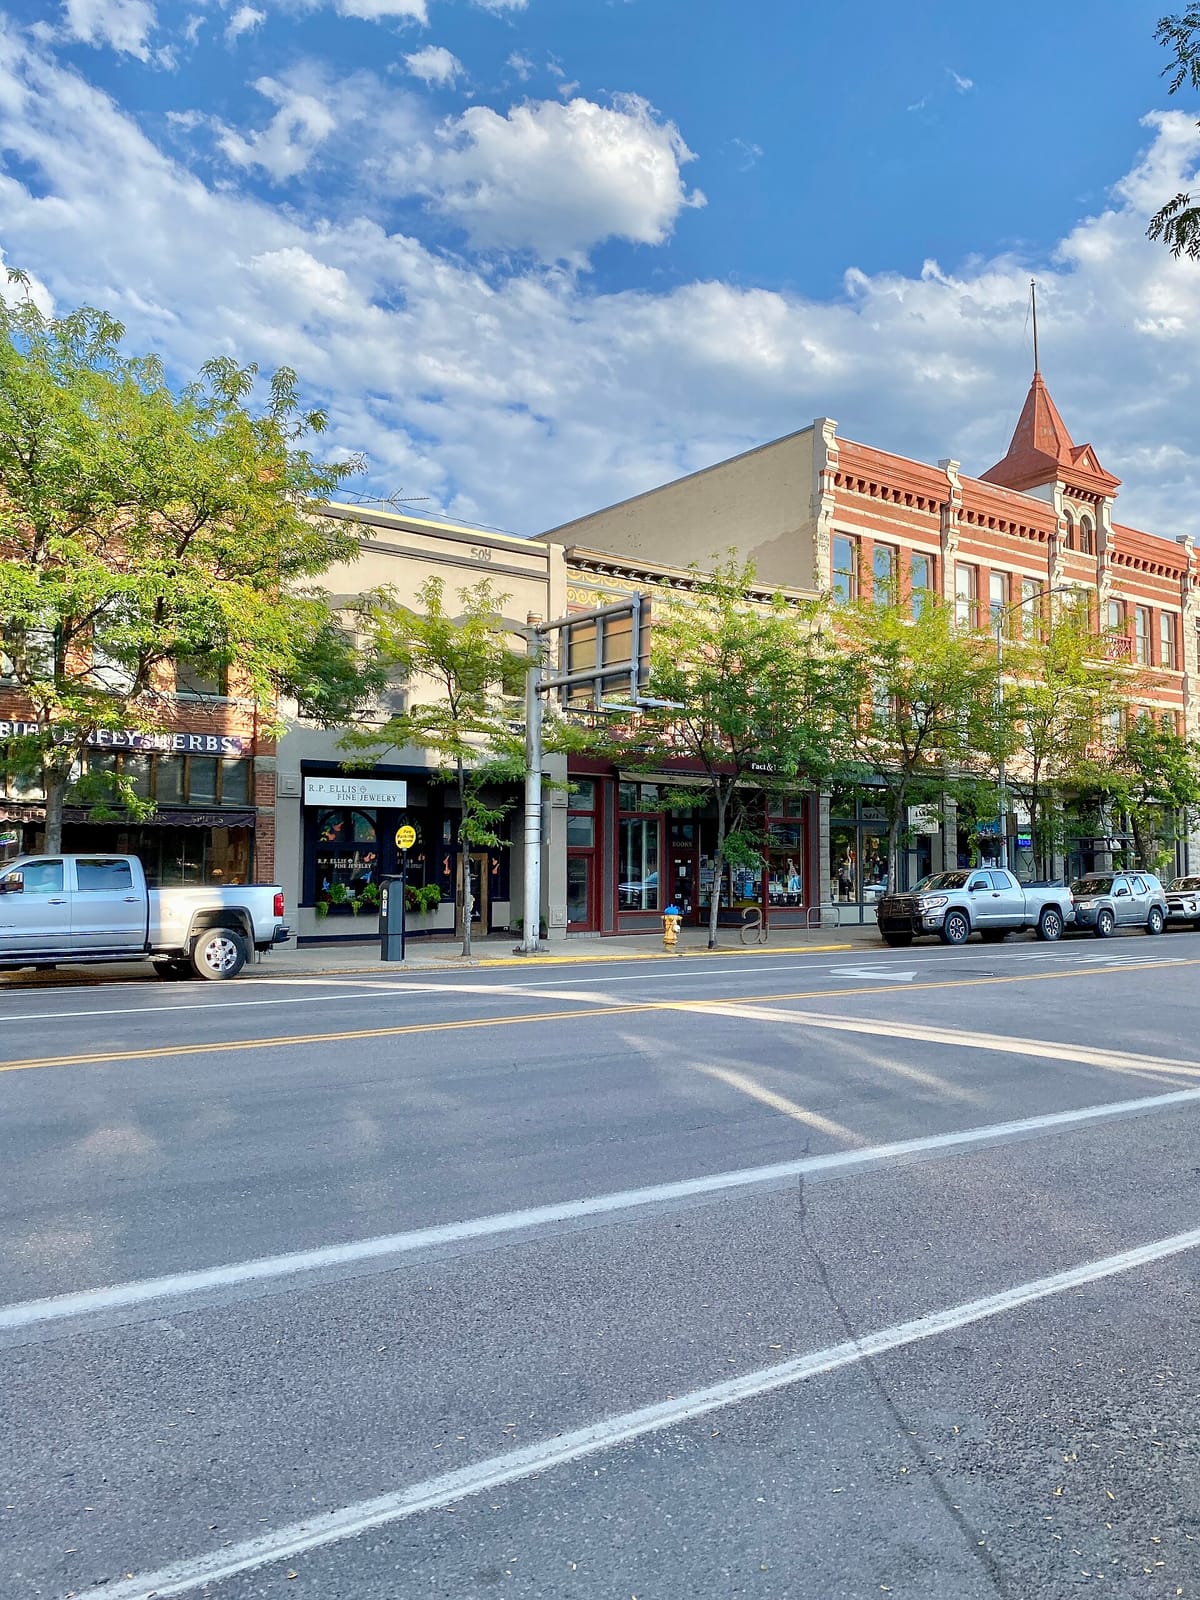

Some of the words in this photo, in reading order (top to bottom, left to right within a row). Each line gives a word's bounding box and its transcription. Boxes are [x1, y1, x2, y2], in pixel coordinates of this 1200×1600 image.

[309, 784, 326, 792] R.P.
[329, 785, 357, 793] ELLIS
[337, 793, 357, 801] FINE
